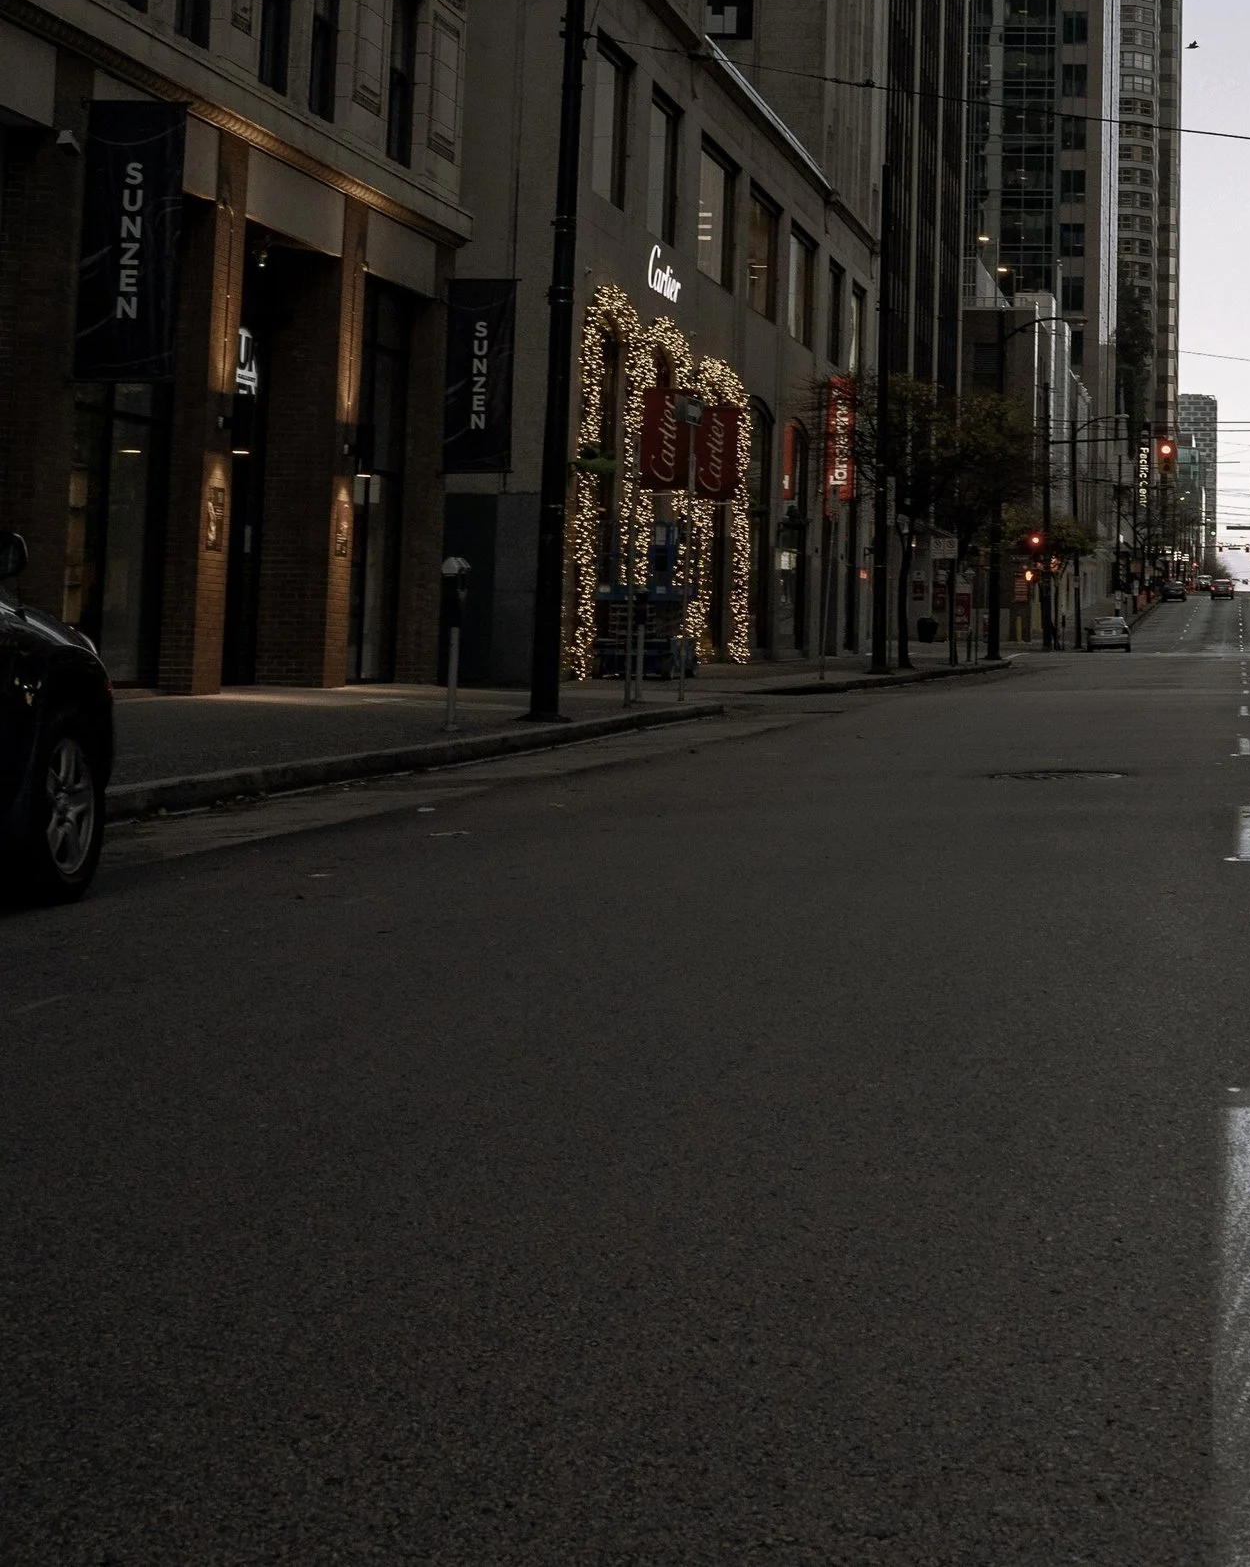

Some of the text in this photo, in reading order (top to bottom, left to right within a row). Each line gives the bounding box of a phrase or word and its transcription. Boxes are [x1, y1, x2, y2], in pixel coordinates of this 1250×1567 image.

[115, 162, 144, 320] SUNZEN
[647, 244, 682, 303] Cartier
[470, 321, 489, 430] SUNZEN
[650, 394, 677, 482] Cartier
[699, 412, 725, 492] Cartier
[1139, 447, 1150, 479] Pacific
